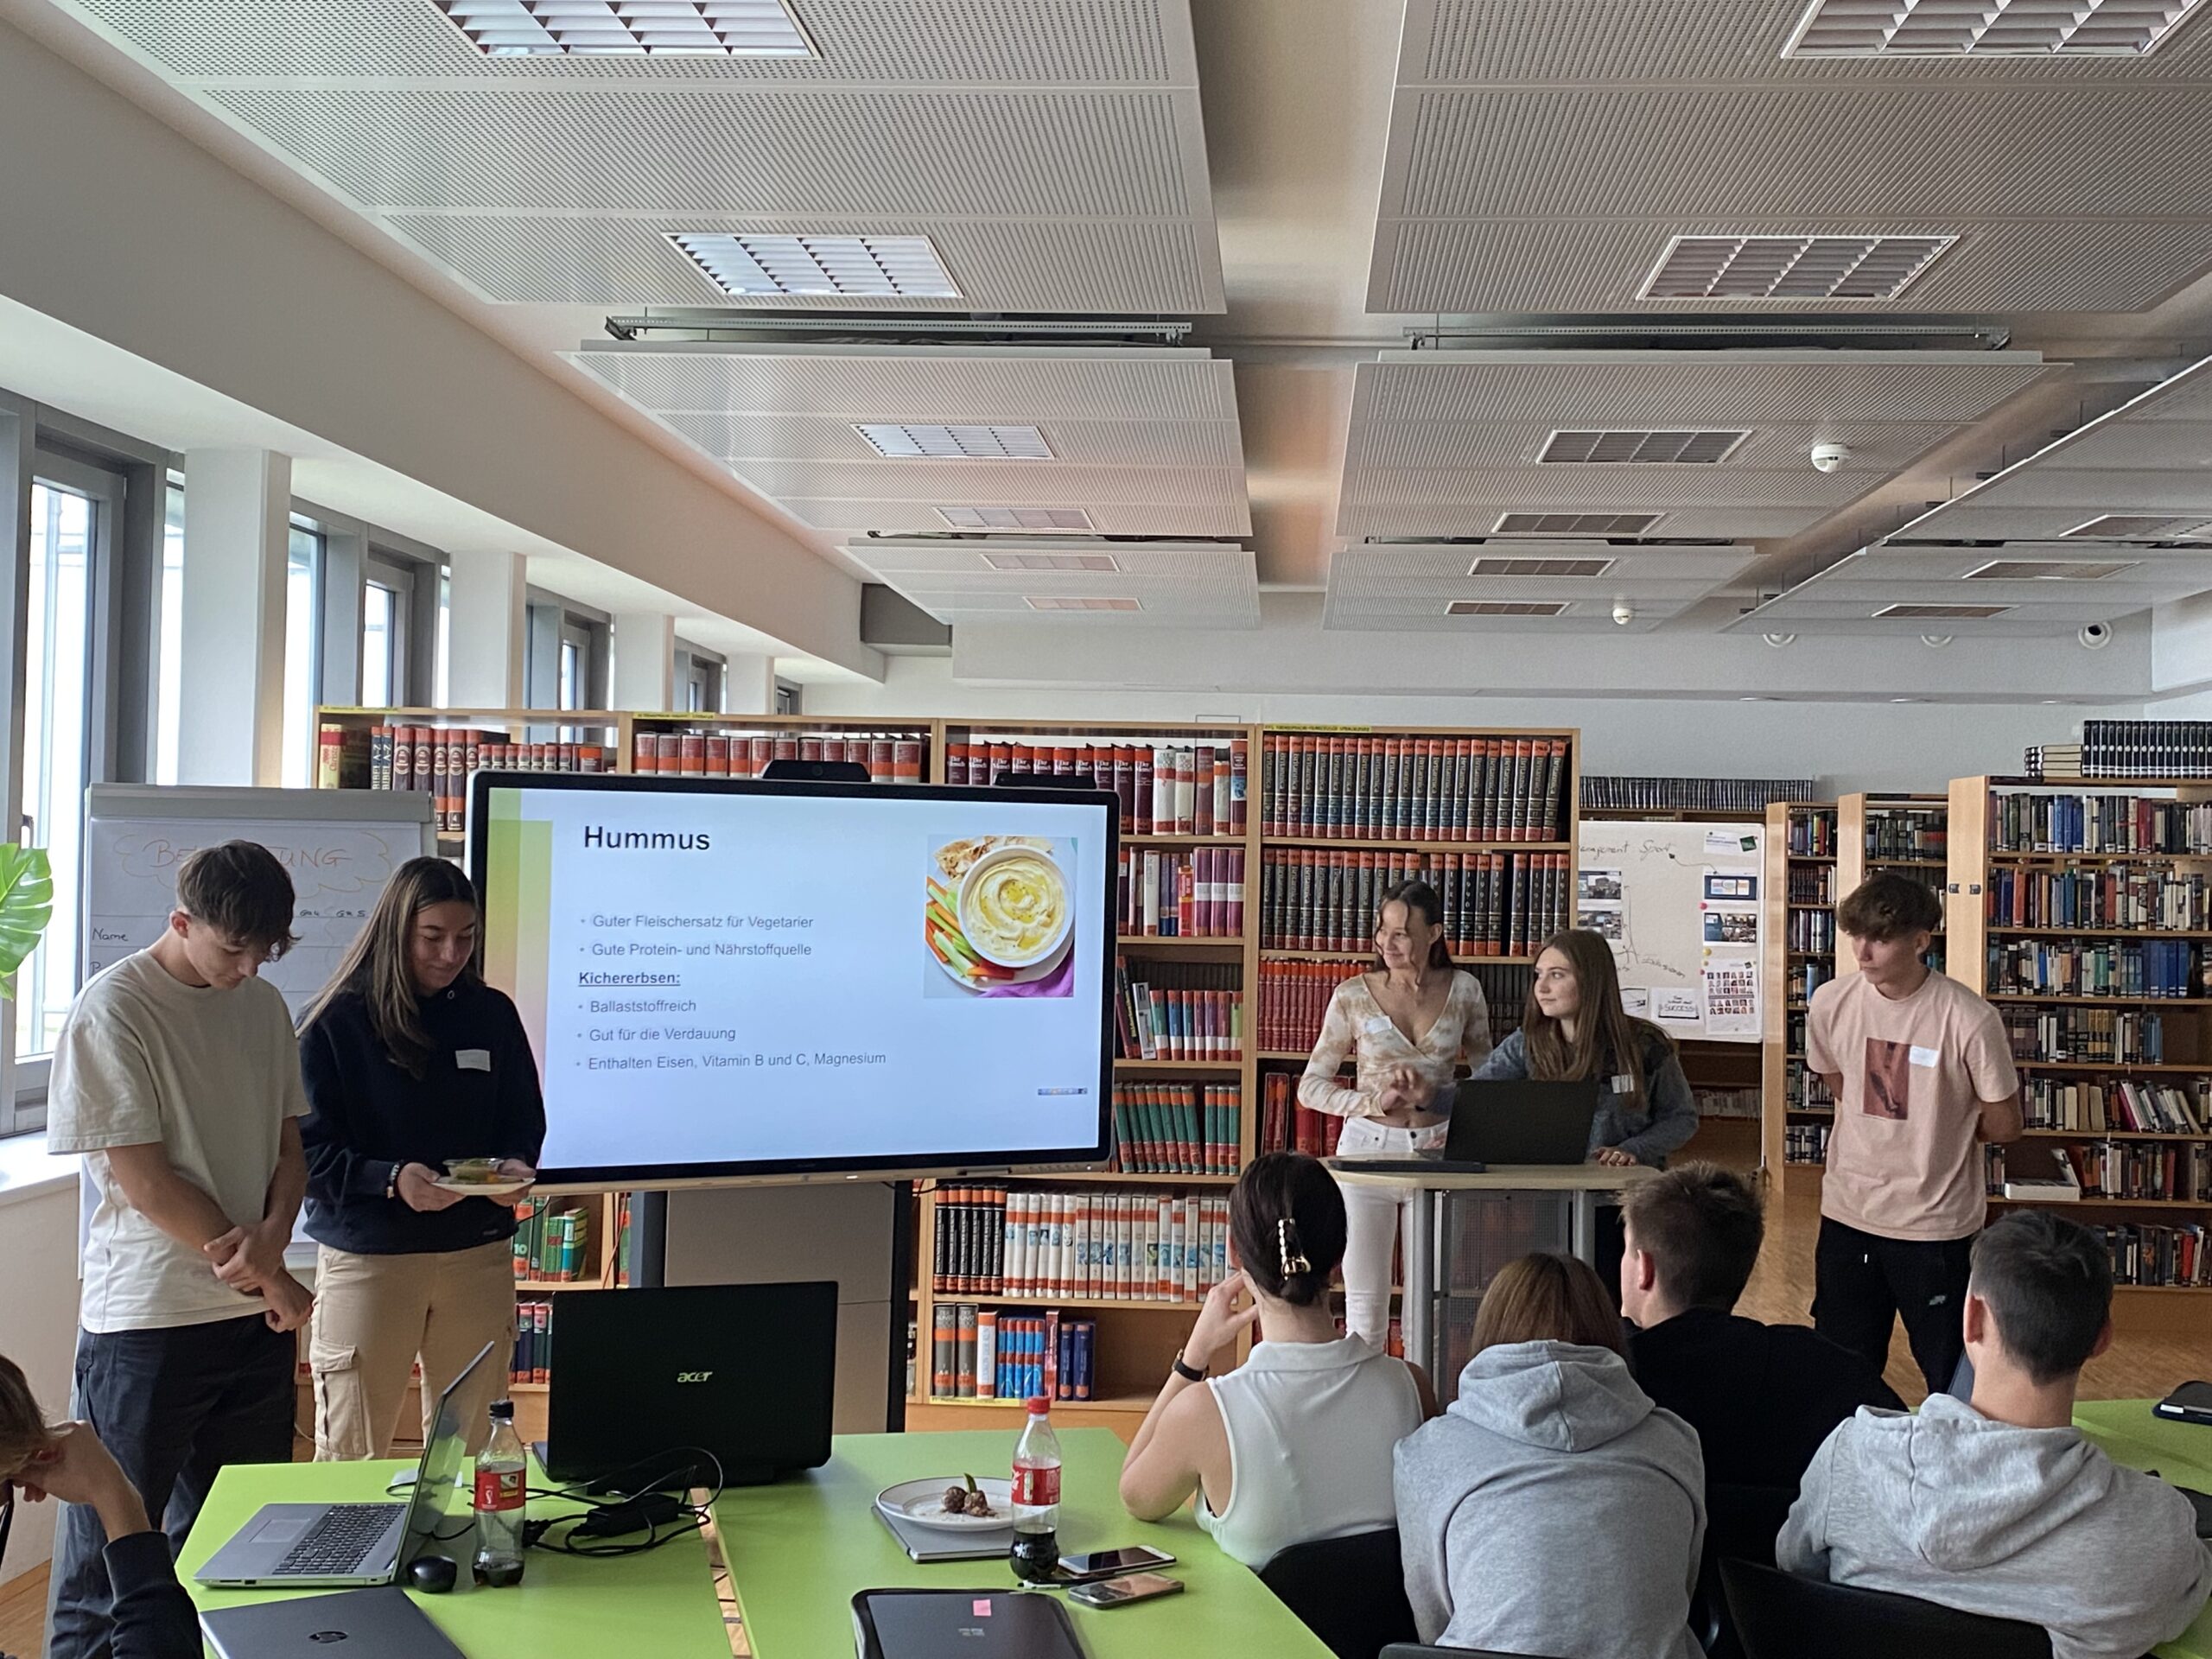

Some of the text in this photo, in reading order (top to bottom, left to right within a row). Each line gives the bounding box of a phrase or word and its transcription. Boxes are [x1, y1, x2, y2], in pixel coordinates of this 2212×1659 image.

[584, 825, 710, 851] Hummus
[593, 914, 814, 931] Guter Fleischersatz für Vegetarier
[92, 927, 129, 942] Name
[592, 942, 812, 958] Gute Protein- und Nährstoffquelle
[579, 971, 681, 988] Kichererbsen:
[590, 999, 696, 1014] Ballaststoffreich
[589, 1027, 736, 1042] Gut für die Verdauung
[588, 1052, 887, 1071] Enthalten Eisen, Vitamin B und C, Magnesium
[513, 1243, 528, 1255] 10
[677, 1371, 713, 1382] acer
